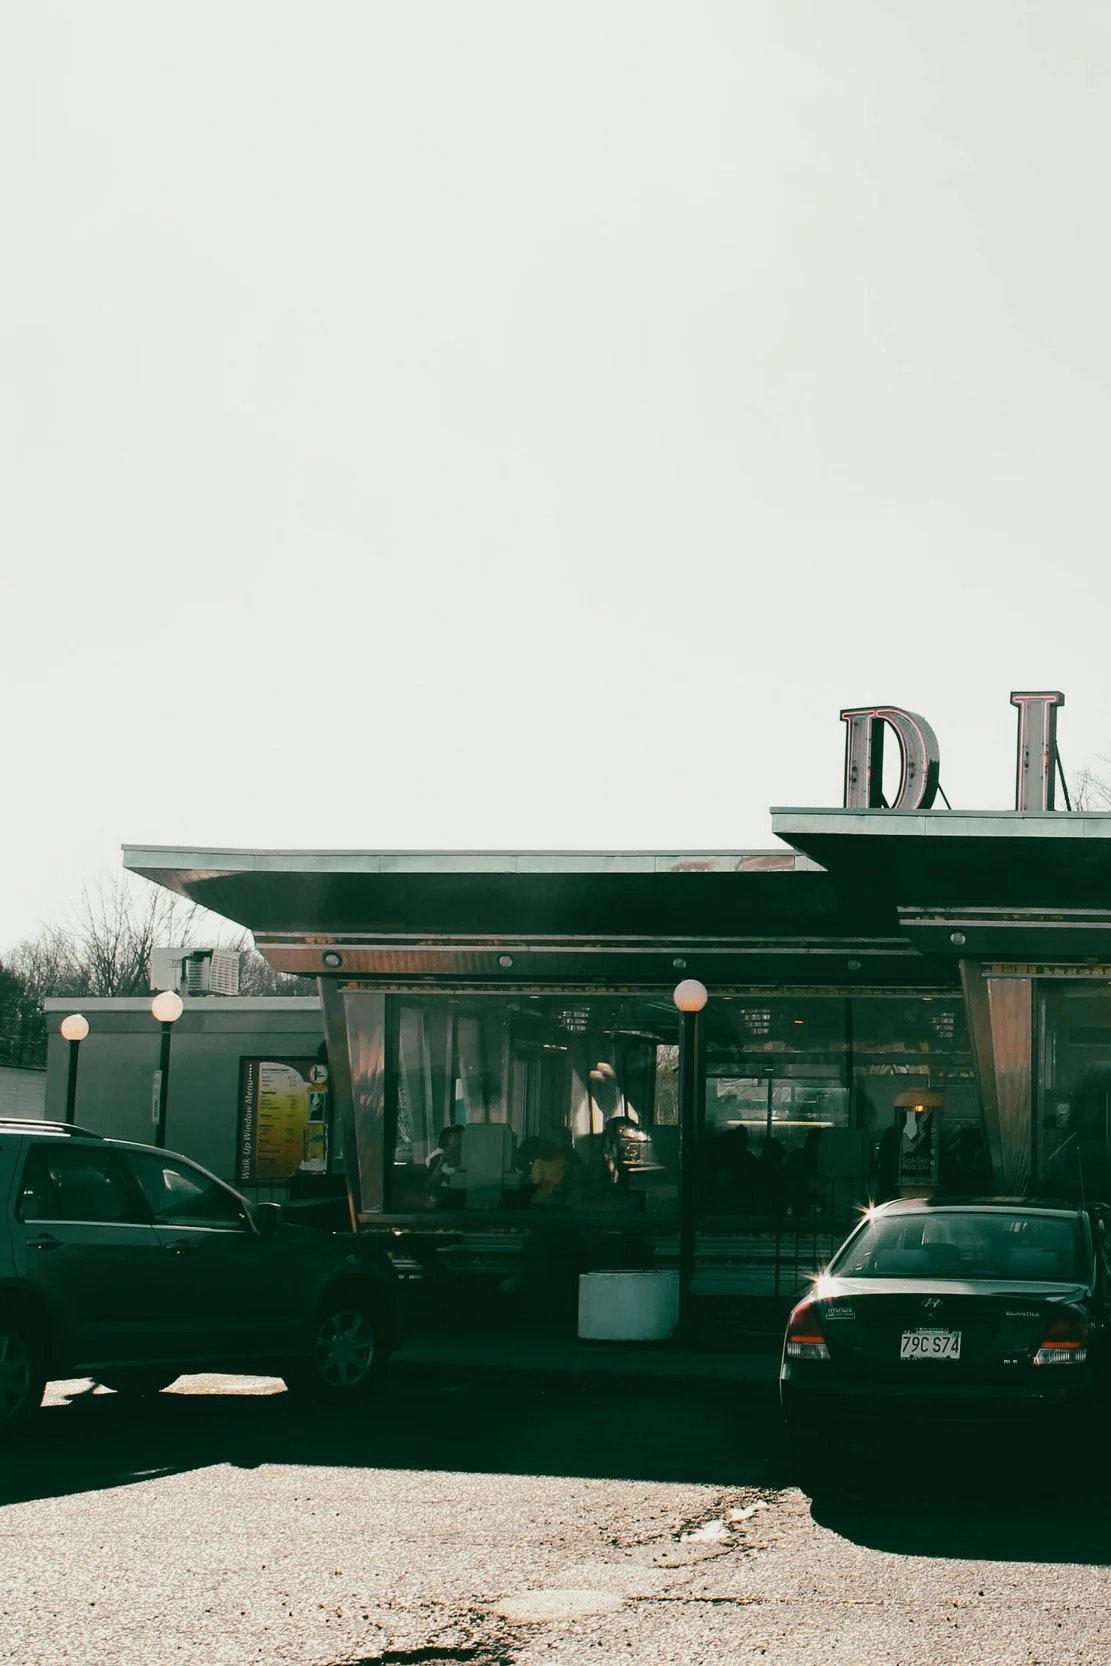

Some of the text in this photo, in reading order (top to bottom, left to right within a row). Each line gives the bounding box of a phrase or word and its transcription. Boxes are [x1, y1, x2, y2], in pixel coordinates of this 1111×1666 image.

[243, 1105, 253, 1142] Window
[240, 1142, 252, 1181] Walk-Up
[902, 1336, 960, 1353] 79C S74
